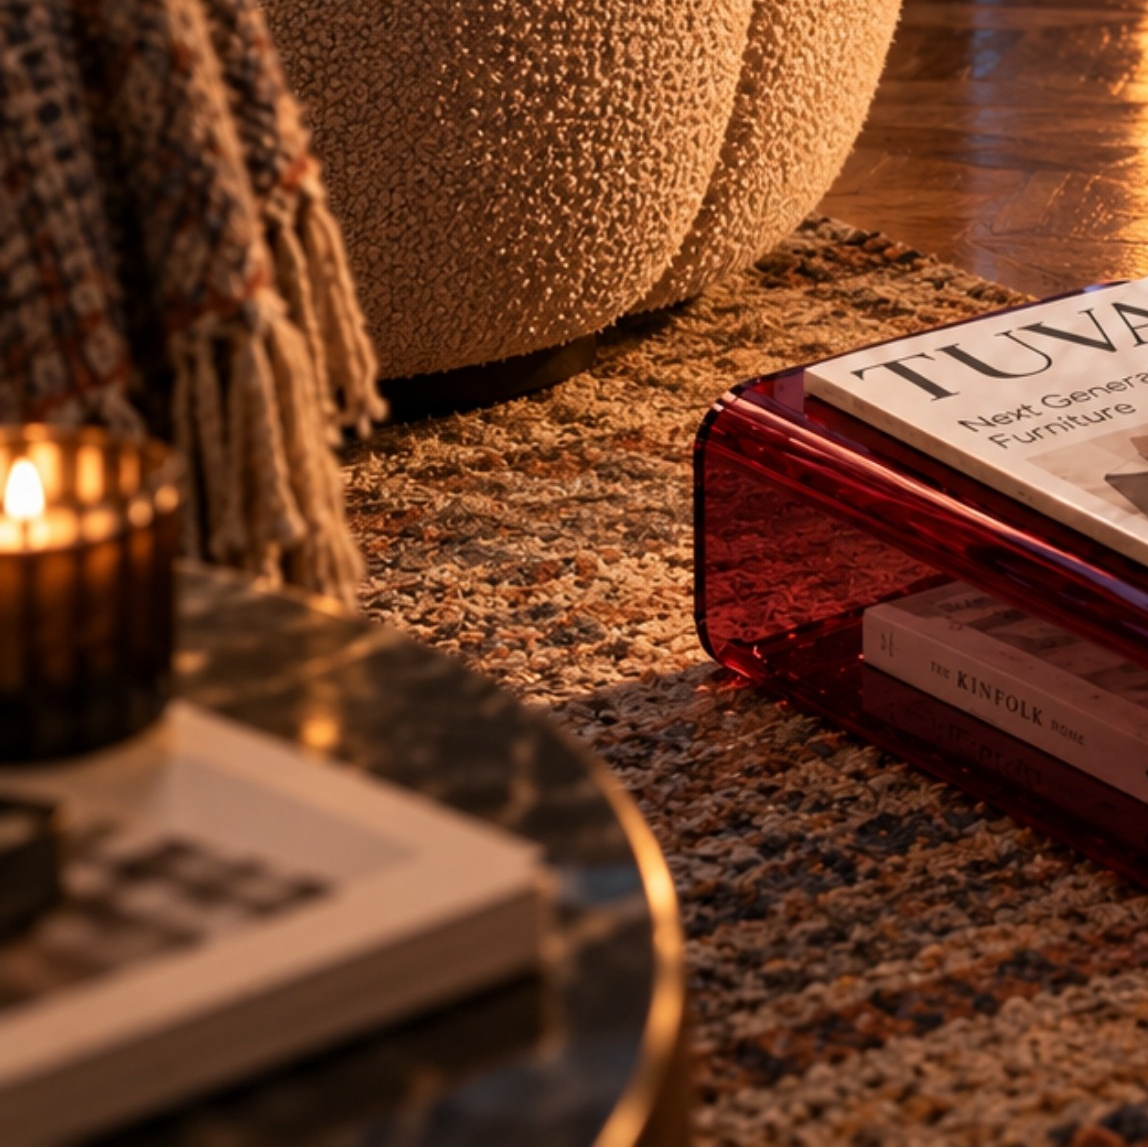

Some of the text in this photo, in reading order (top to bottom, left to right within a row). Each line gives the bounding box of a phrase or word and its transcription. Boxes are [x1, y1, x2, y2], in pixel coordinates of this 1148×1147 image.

[957, 403, 1041, 433] Next
[987, 399, 1137, 450] Furniture
[955, 669, 1043, 727] KINFOLK
